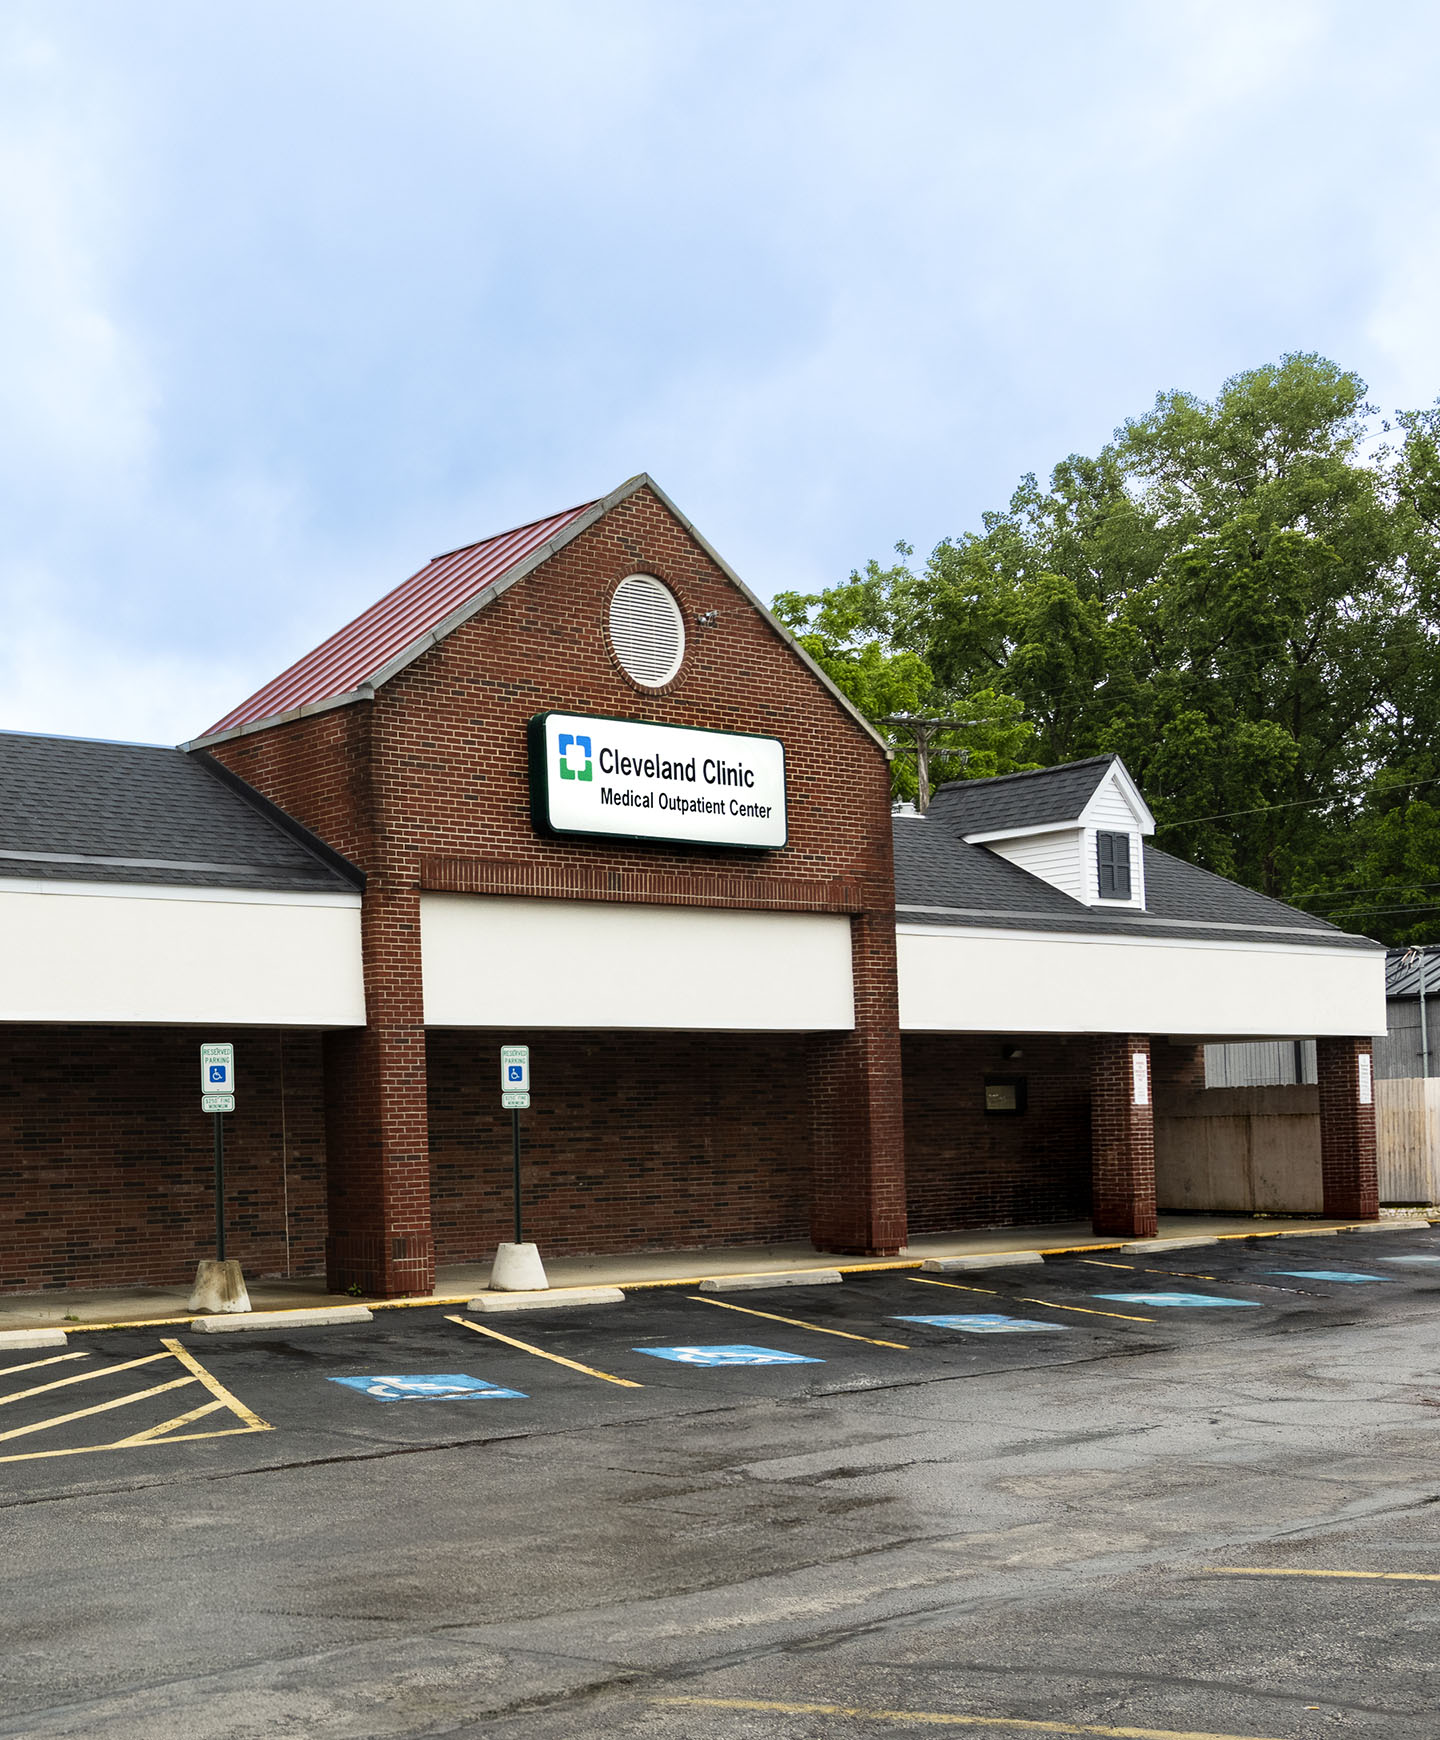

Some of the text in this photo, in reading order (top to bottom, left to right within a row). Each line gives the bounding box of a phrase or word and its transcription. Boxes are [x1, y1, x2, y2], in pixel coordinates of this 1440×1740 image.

[599, 747, 755, 788] Cleveland Clinic
[600, 787, 772, 819] Medical Outpatient Center
[203, 1048, 231, 1056] RESERVED
